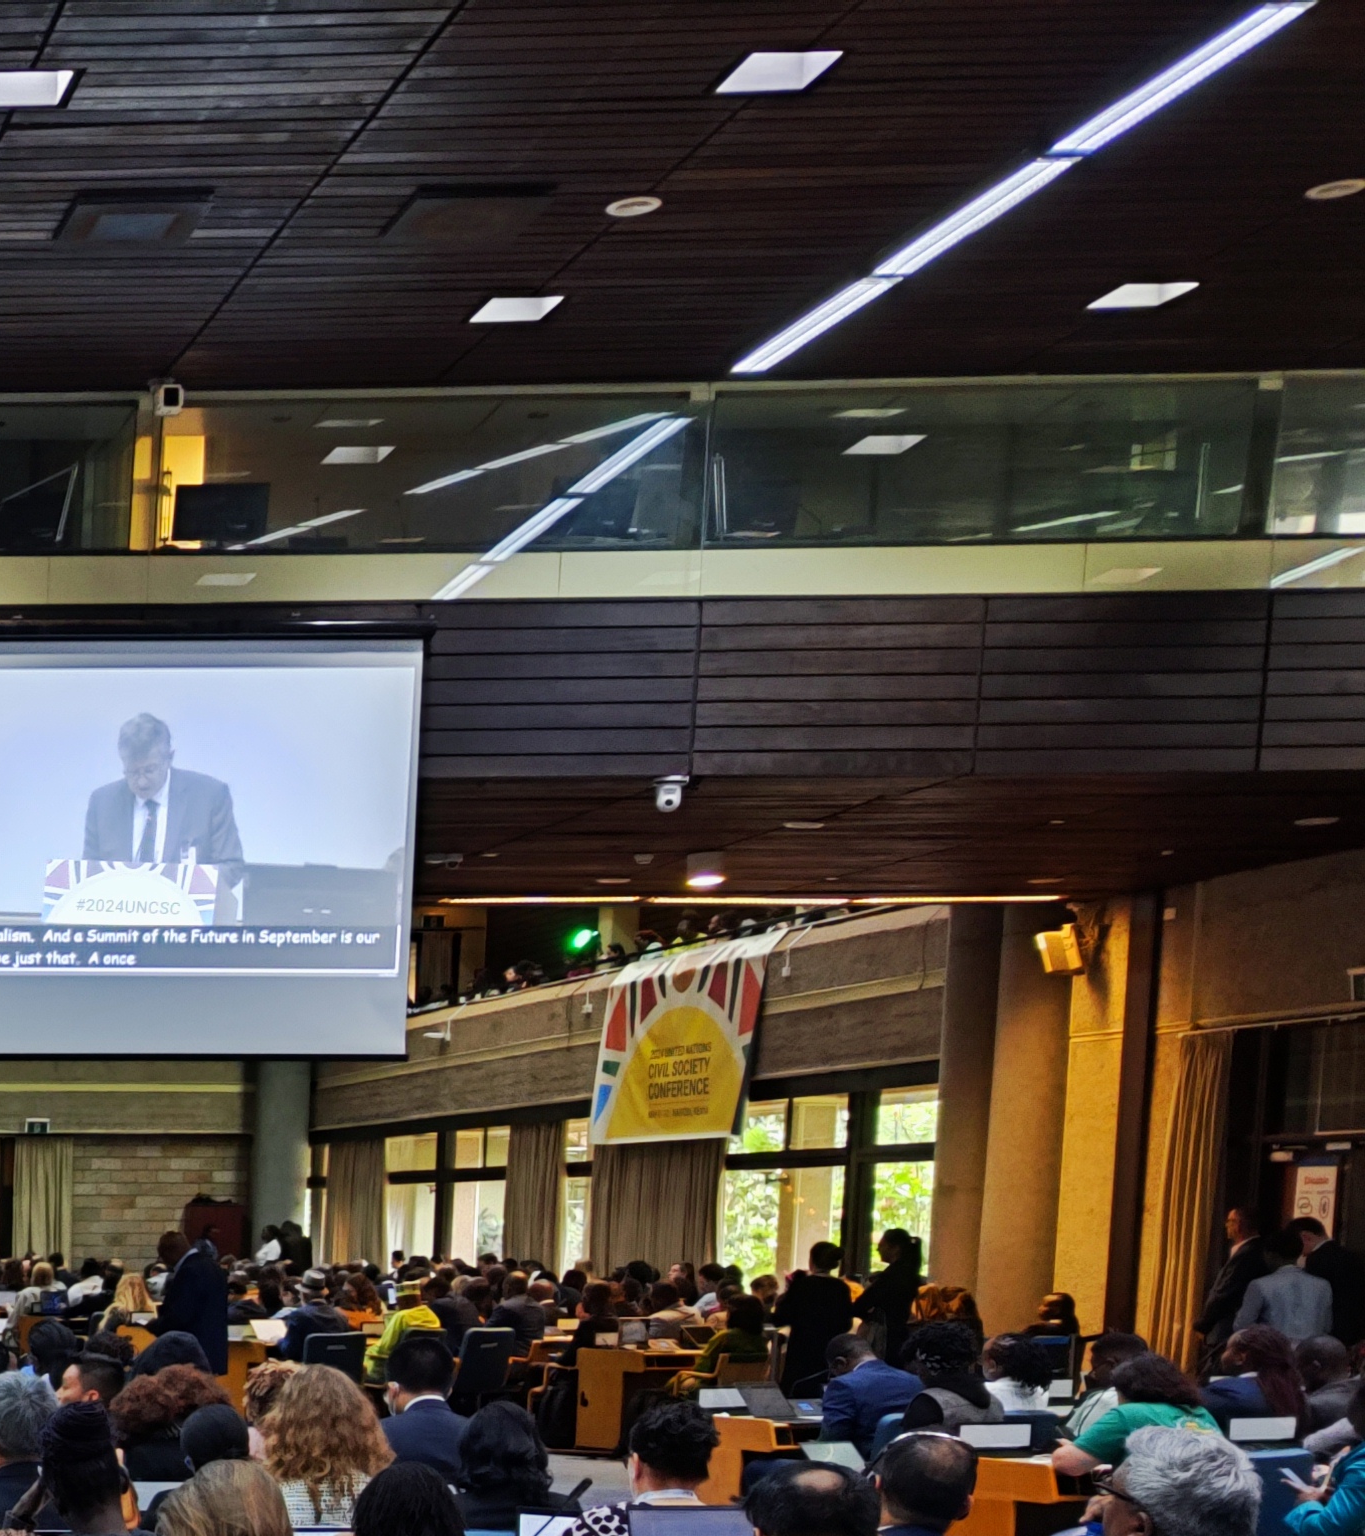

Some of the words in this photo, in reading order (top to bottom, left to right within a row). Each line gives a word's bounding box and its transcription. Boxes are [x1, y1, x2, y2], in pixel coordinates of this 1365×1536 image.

[76, 899, 181, 915] #2024UNCSC
[43, 928, 70, 942] And
[74, 932, 83, 942] a
[86, 928, 139, 943] Summit
[142, 929, 159, 943] of
[162, 929, 187, 943] the
[191, 930, 238, 943] Future
[242, 929, 255, 943] in
[258, 929, 336, 947] September
[340, 930, 352, 943] is
[355, 933, 380, 943] our
[13, 951, 41, 968] just
[88, 952, 99, 964] A
[103, 954, 136, 965] once
[649, 1063, 669, 1079] CIVIL
[672, 1057, 710, 1077] SOCIETY
[649, 1077, 709, 1100] CONFERENCE
